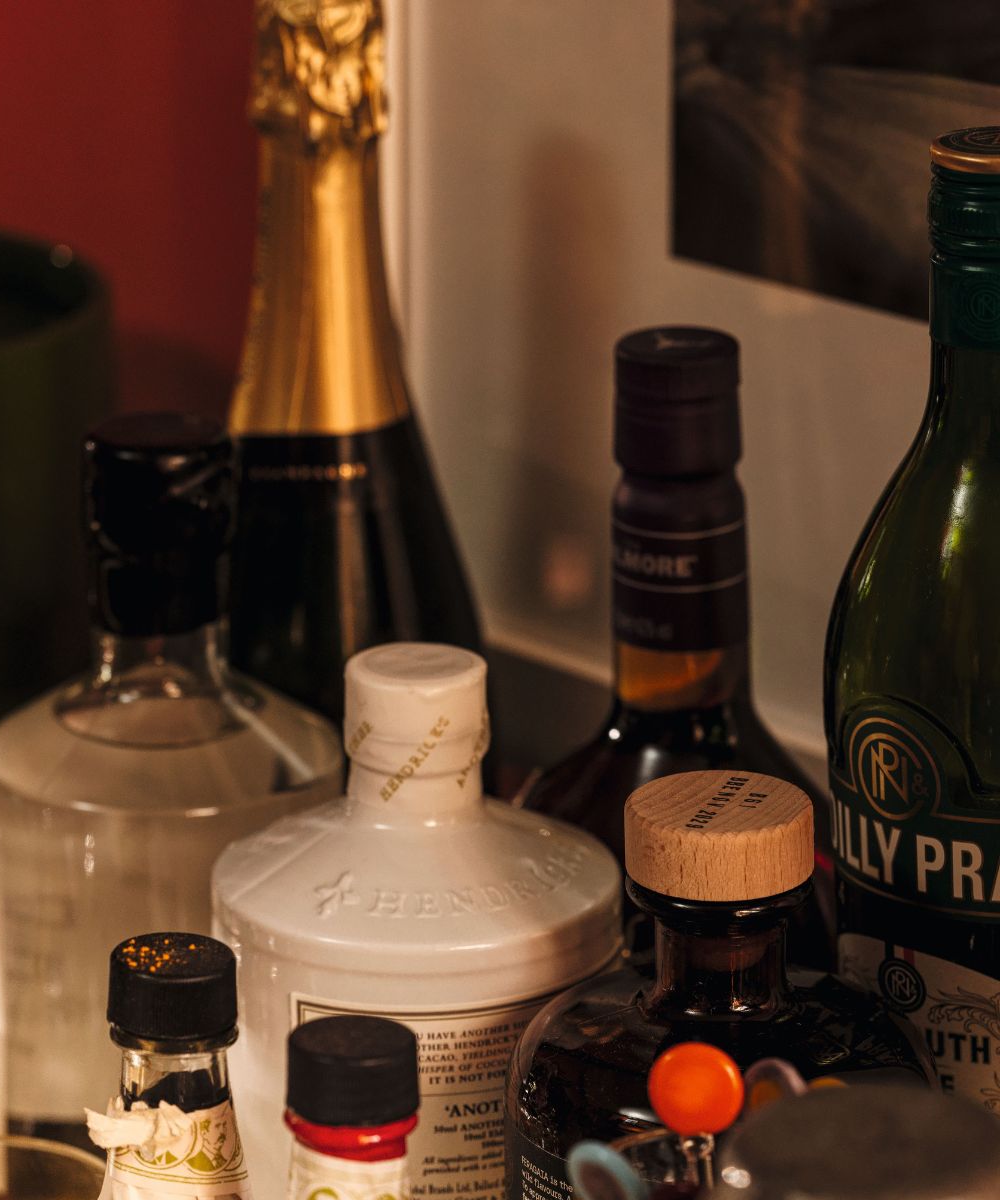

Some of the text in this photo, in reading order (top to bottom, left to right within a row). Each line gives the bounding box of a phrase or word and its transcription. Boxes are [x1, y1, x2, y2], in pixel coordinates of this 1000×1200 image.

[428, 1031, 457, 1040] HAVE
[925, 1028, 991, 1065] UTH
[459, 1063, 472, 1072] OF
[429, 1076, 440, 1085] IT
[445, 1075, 456, 1085] IS
[459, 1073, 484, 1083] NOT
[550, 1175, 558, 1186] is
[560, 1180, 573, 1193] the
